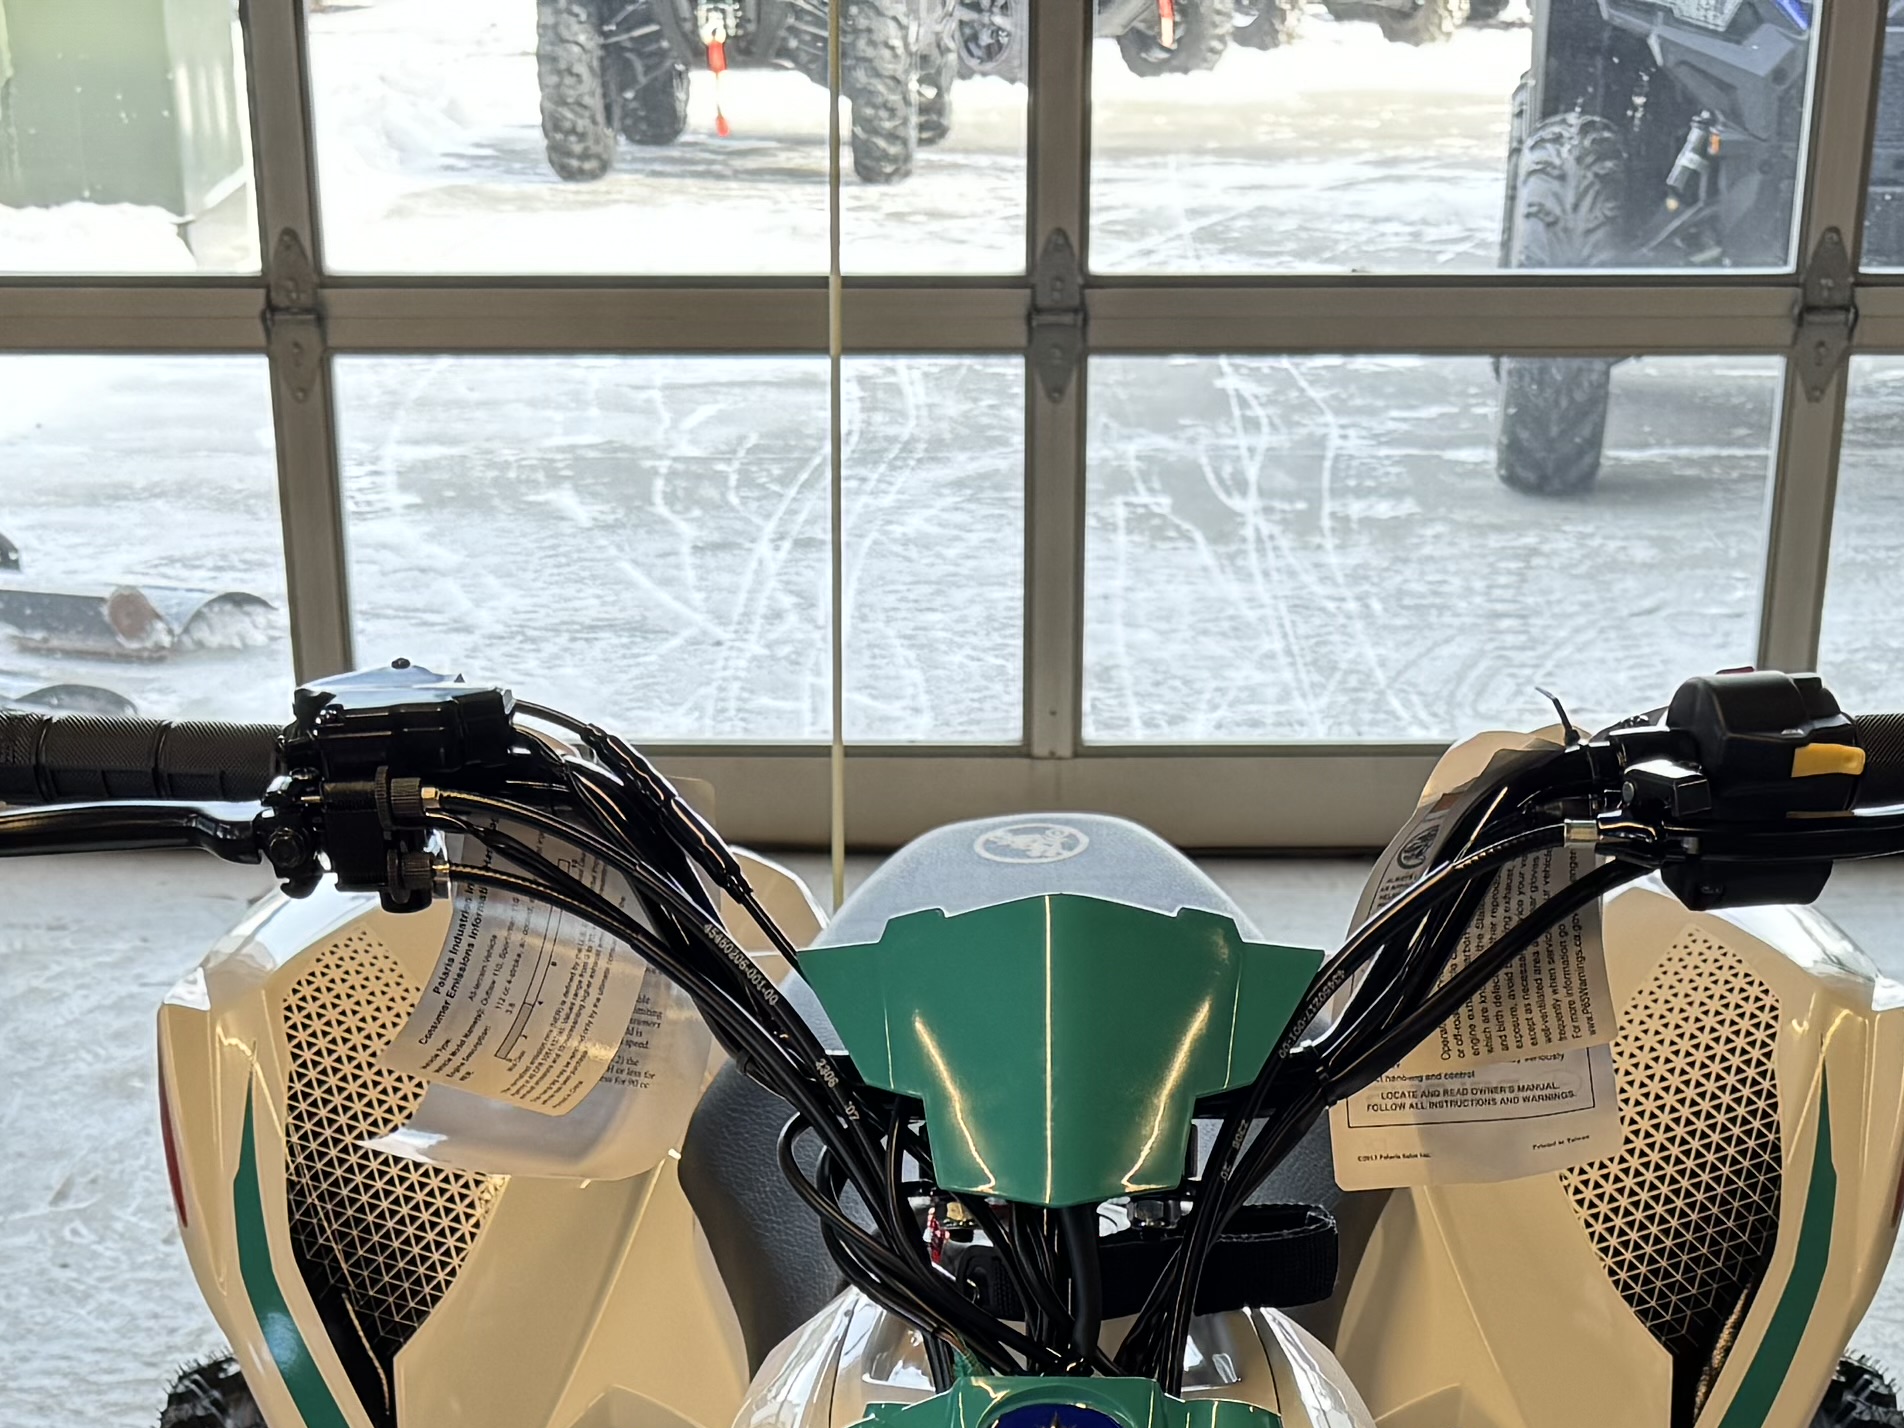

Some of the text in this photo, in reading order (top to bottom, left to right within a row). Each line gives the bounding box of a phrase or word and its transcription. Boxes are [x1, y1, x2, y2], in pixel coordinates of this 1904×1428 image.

[1516, 871, 1527, 896] your
[1474, 933, 1485, 952] the
[431, 955, 455, 995] Polaris
[1503, 971, 1515, 1000] avoid
[1546, 967, 1558, 995] when
[1556, 922, 1581, 1039] For more information go
[417, 999, 451, 1044] Consumer
[444, 941, 475, 999] Emissions
[1530, 950, 1552, 1044] well-ventilated area
[1480, 1006, 1488, 1023] are
[1490, 974, 1508, 1051] and birth defec
[1524, 1002, 1532, 1014] as
[1551, 996, 1567, 1041] frequently
[1451, 1012, 1463, 1046] off-roa
[1467, 1023, 1481, 1056] engine
[1481, 1026, 1493, 1054] which
[1508, 1002, 1523, 1049] exposure,
[1524, 1016, 1538, 1046] except
[1437, 1022, 1452, 1060] Operat
[1424, 1072, 1441, 1080] and
[1443, 1069, 1475, 1080] control
[1366, 1100, 1405, 1113] FOLLOW
[1408, 1101, 1425, 1110] ALL
[1428, 1097, 1496, 1109] INSTRUCTIONS
[1499, 1096, 1519, 1105] AND
[1380, 1089, 1418, 1101] LOCATE
[1420, 1088, 1440, 1098] AND
[1442, 1086, 1468, 1097] READ
[1470, 1083, 1514, 1097] OWNER'S
